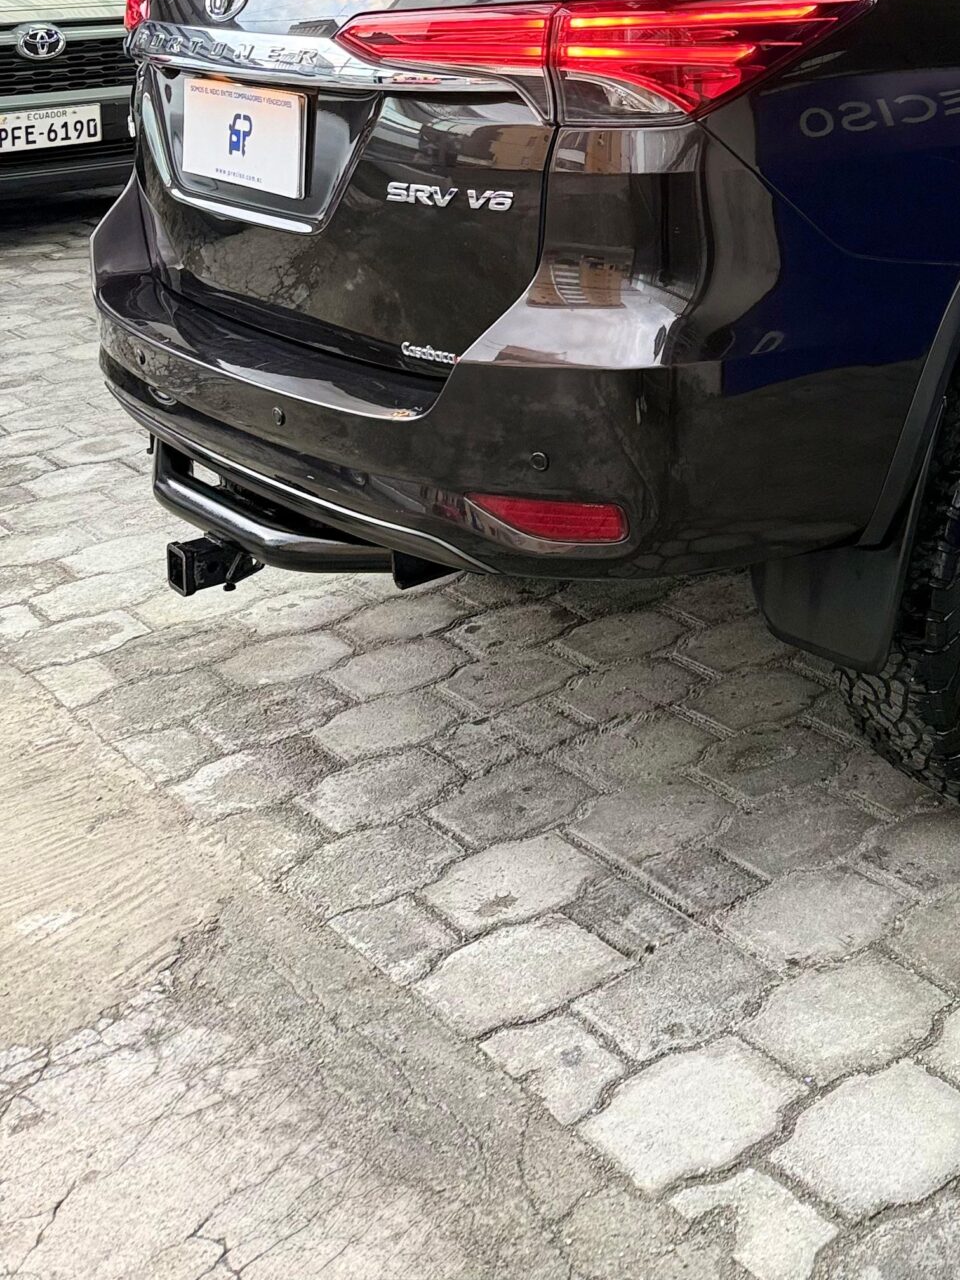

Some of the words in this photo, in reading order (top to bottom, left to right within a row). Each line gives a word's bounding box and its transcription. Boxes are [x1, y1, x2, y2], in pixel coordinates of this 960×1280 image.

[137, 28, 319, 65] FORTUNER
[27, 110, 68, 120] ECUADOR
[0, 118, 98, 148] PFE-6190
[386, 181, 459, 208] SRV
[466, 189, 514, 211] V6
[401, 341, 456, 365] Casabaca
